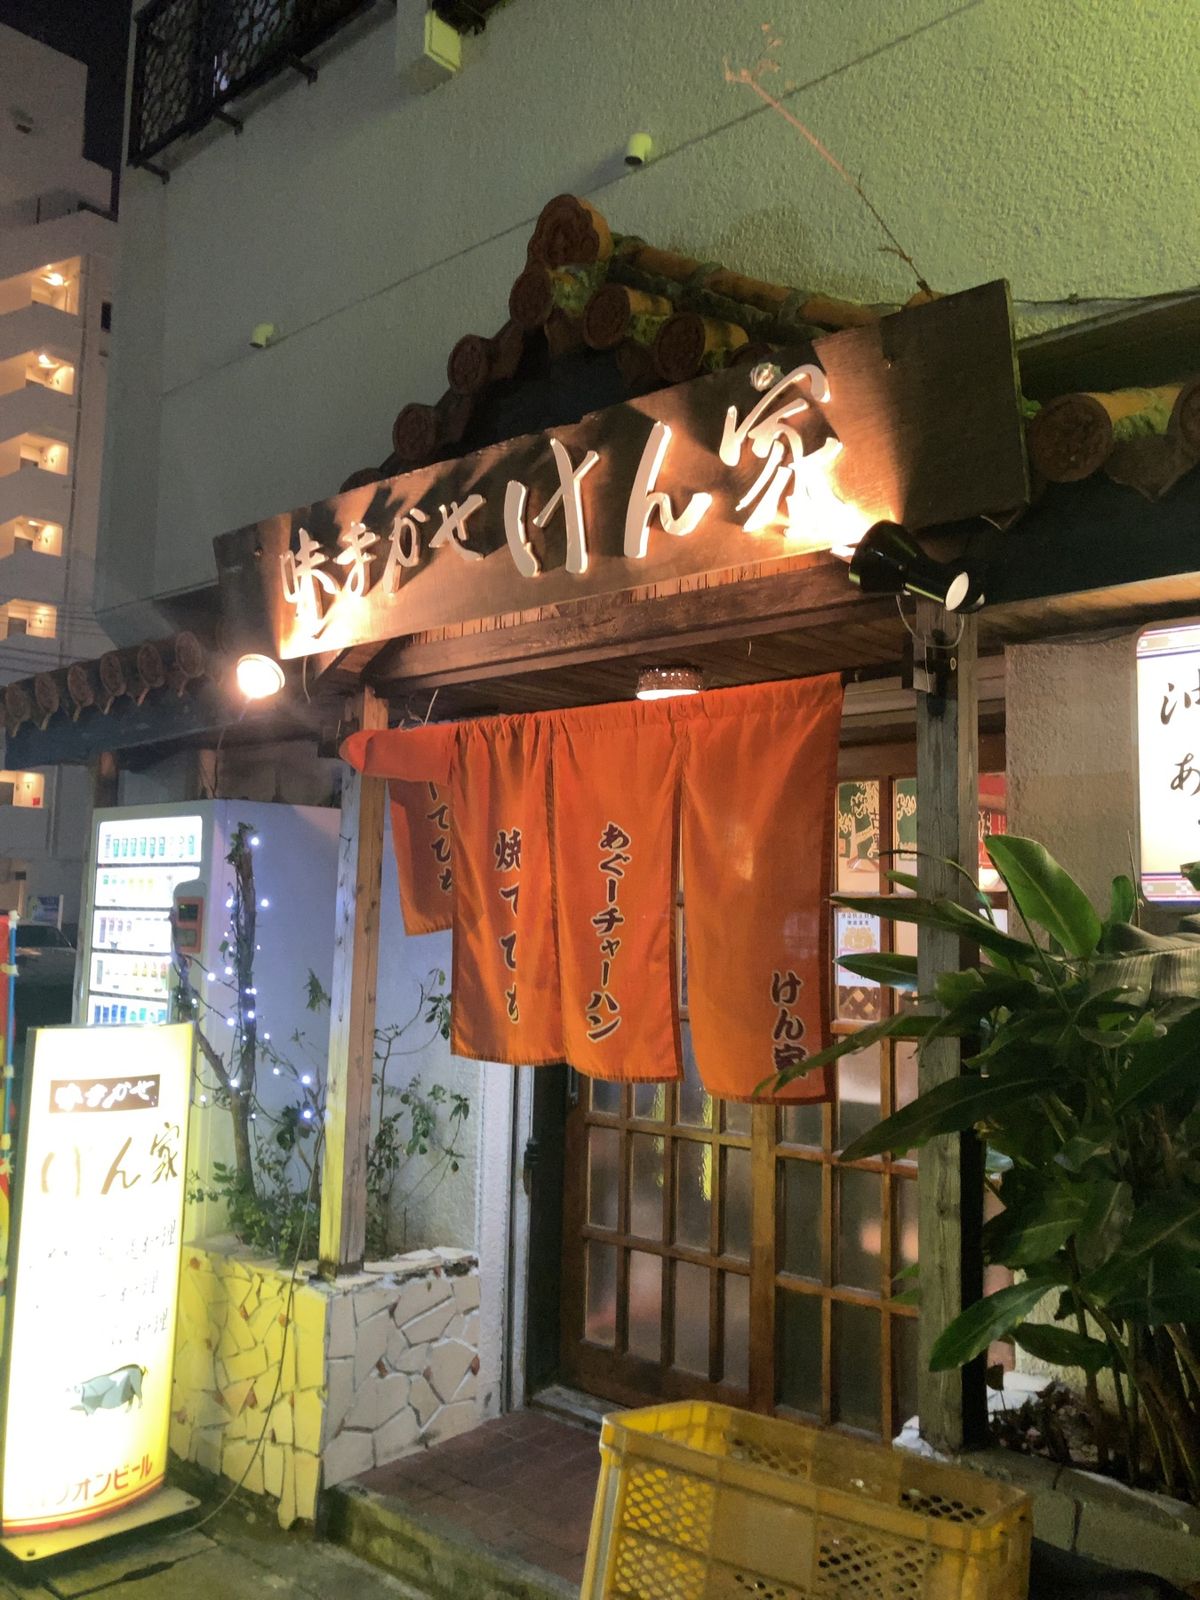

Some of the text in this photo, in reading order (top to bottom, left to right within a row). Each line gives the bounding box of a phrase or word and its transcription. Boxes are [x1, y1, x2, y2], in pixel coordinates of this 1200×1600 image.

[586, 821, 632, 1043] あぐーチャーハン
